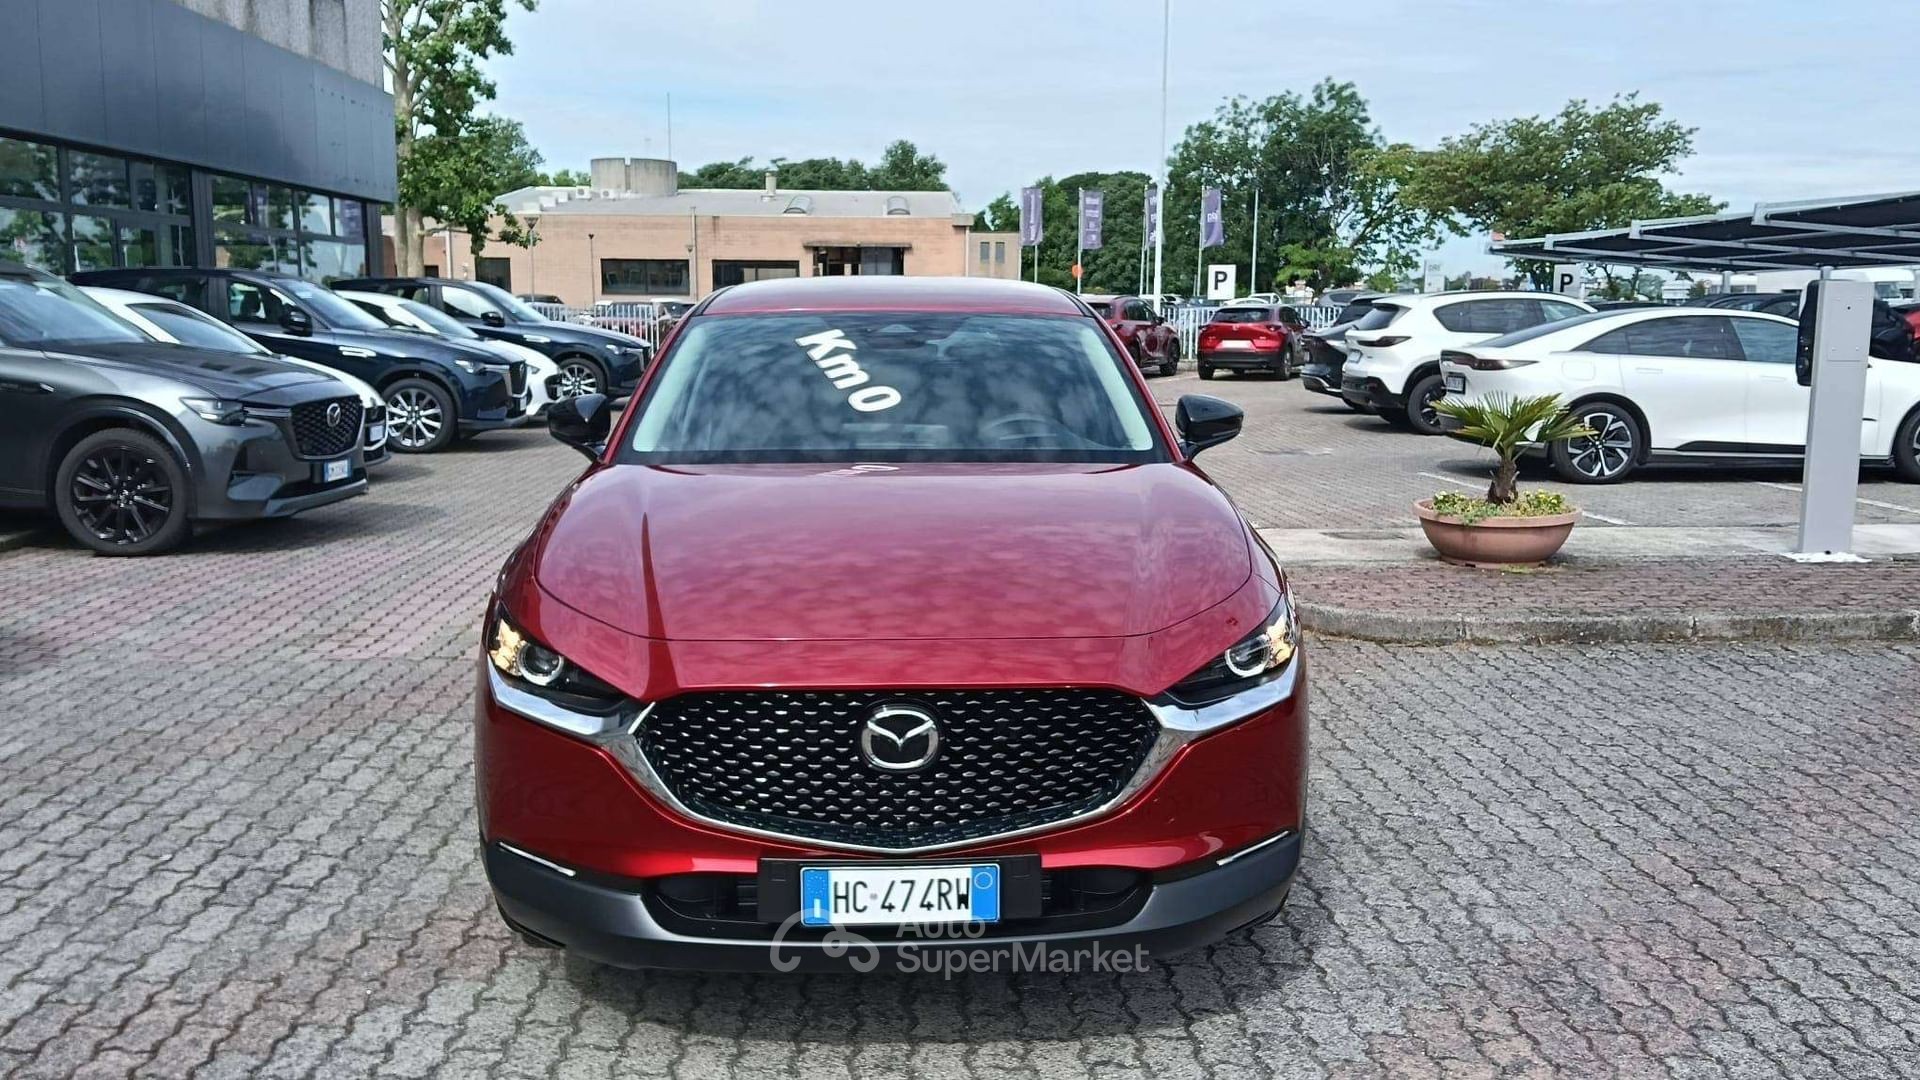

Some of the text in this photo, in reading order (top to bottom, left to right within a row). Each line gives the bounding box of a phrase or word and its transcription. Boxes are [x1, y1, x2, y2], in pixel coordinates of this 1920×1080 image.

[1214, 271, 1228, 290] P
[1560, 273, 1574, 292] P
[795, 329, 869, 390] Km
